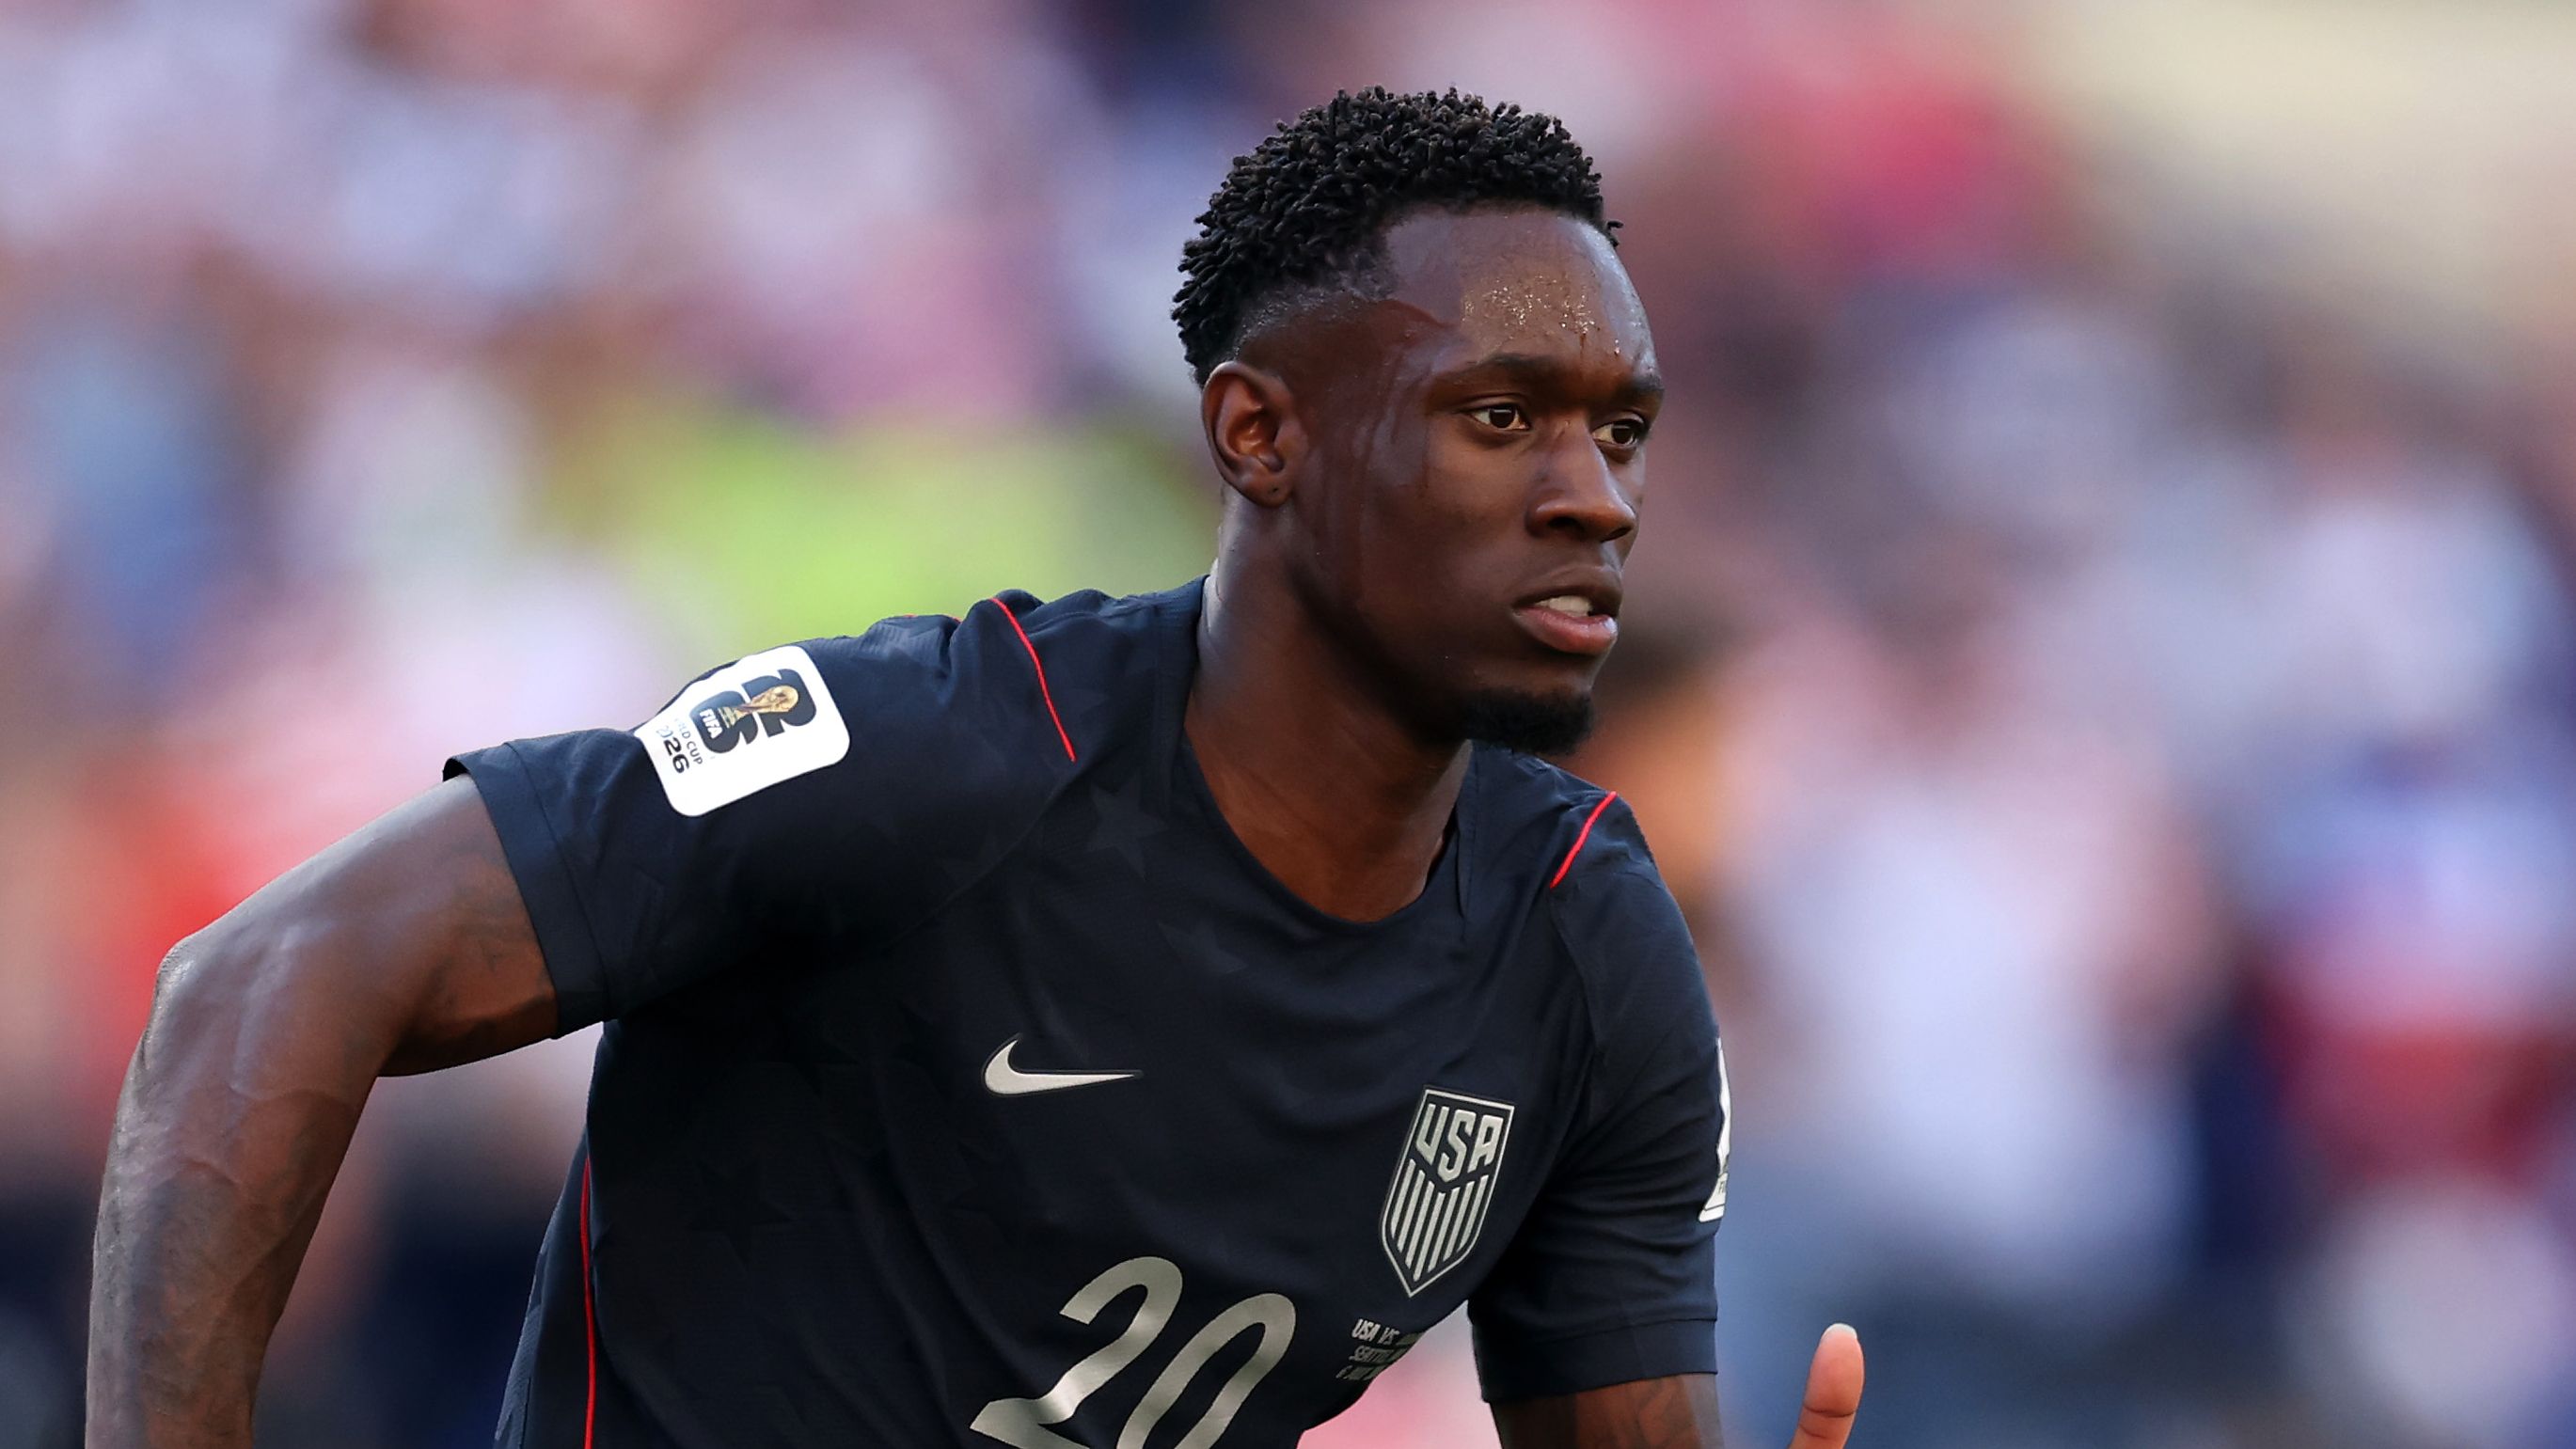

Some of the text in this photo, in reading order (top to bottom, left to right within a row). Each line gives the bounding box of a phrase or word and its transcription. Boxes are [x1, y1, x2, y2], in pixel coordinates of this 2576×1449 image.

[699, 708, 722, 739] FIFA
[686, 741, 703, 764] CUP
[1415, 1103, 1504, 1182] USA
[1351, 1318, 1381, 1342] USA
[970, 1256, 1296, 1449] 20
